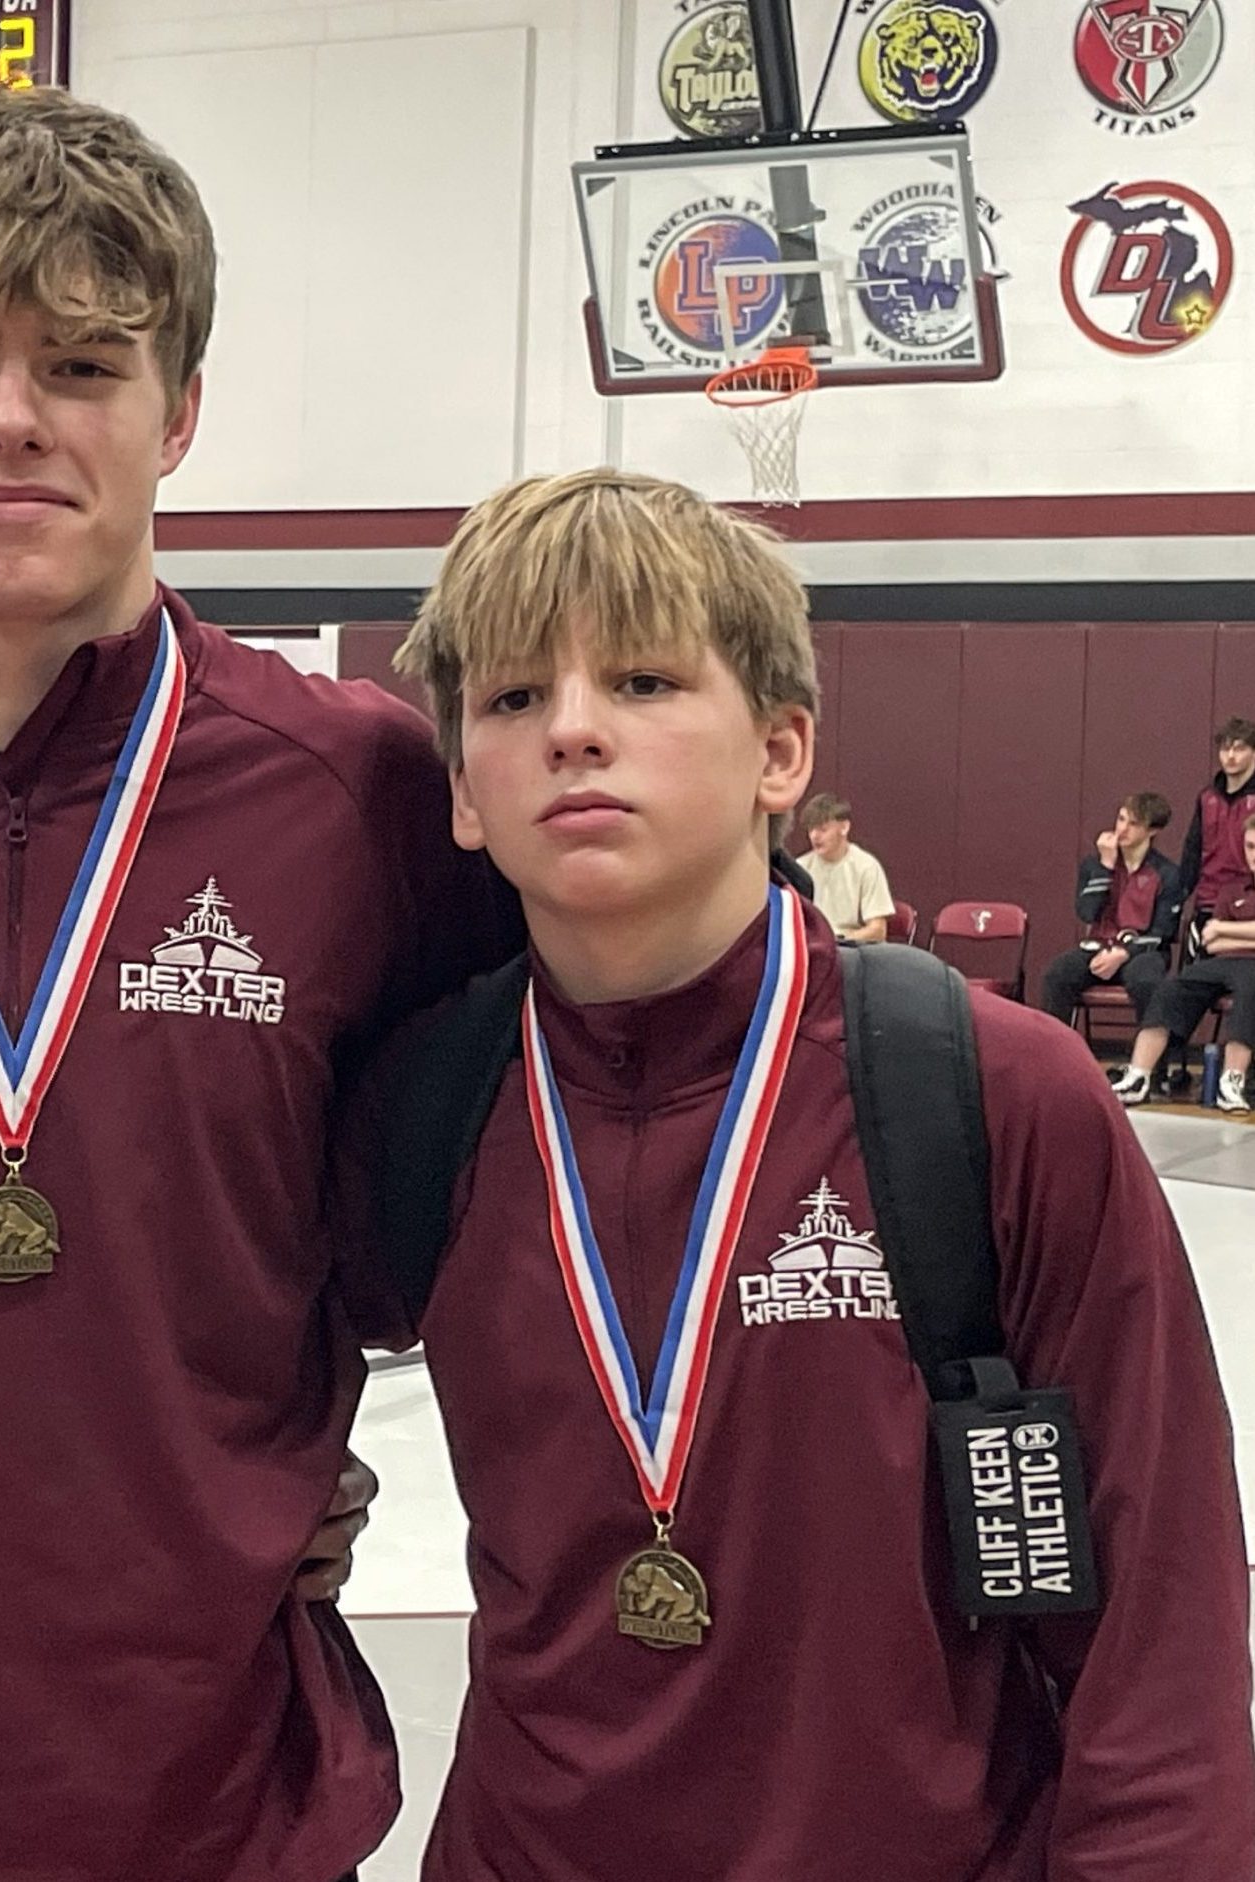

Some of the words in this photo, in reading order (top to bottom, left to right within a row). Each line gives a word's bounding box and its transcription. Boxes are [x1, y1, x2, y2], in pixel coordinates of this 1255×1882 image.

[674, 66, 760, 112] TAYLO
[1093, 106, 1196, 135] TITANS
[852, 182, 1003, 232] WOODHAEN
[639, 196, 735, 269] LINCOLN
[119, 990, 285, 1024] WRESTLING
[120, 962, 286, 1004] DEXTER
[966, 1427, 1015, 1508] KEEN
[1018, 1452, 1073, 1594] ATHLETIC
[975, 1516, 1024, 1598] CLIFF
